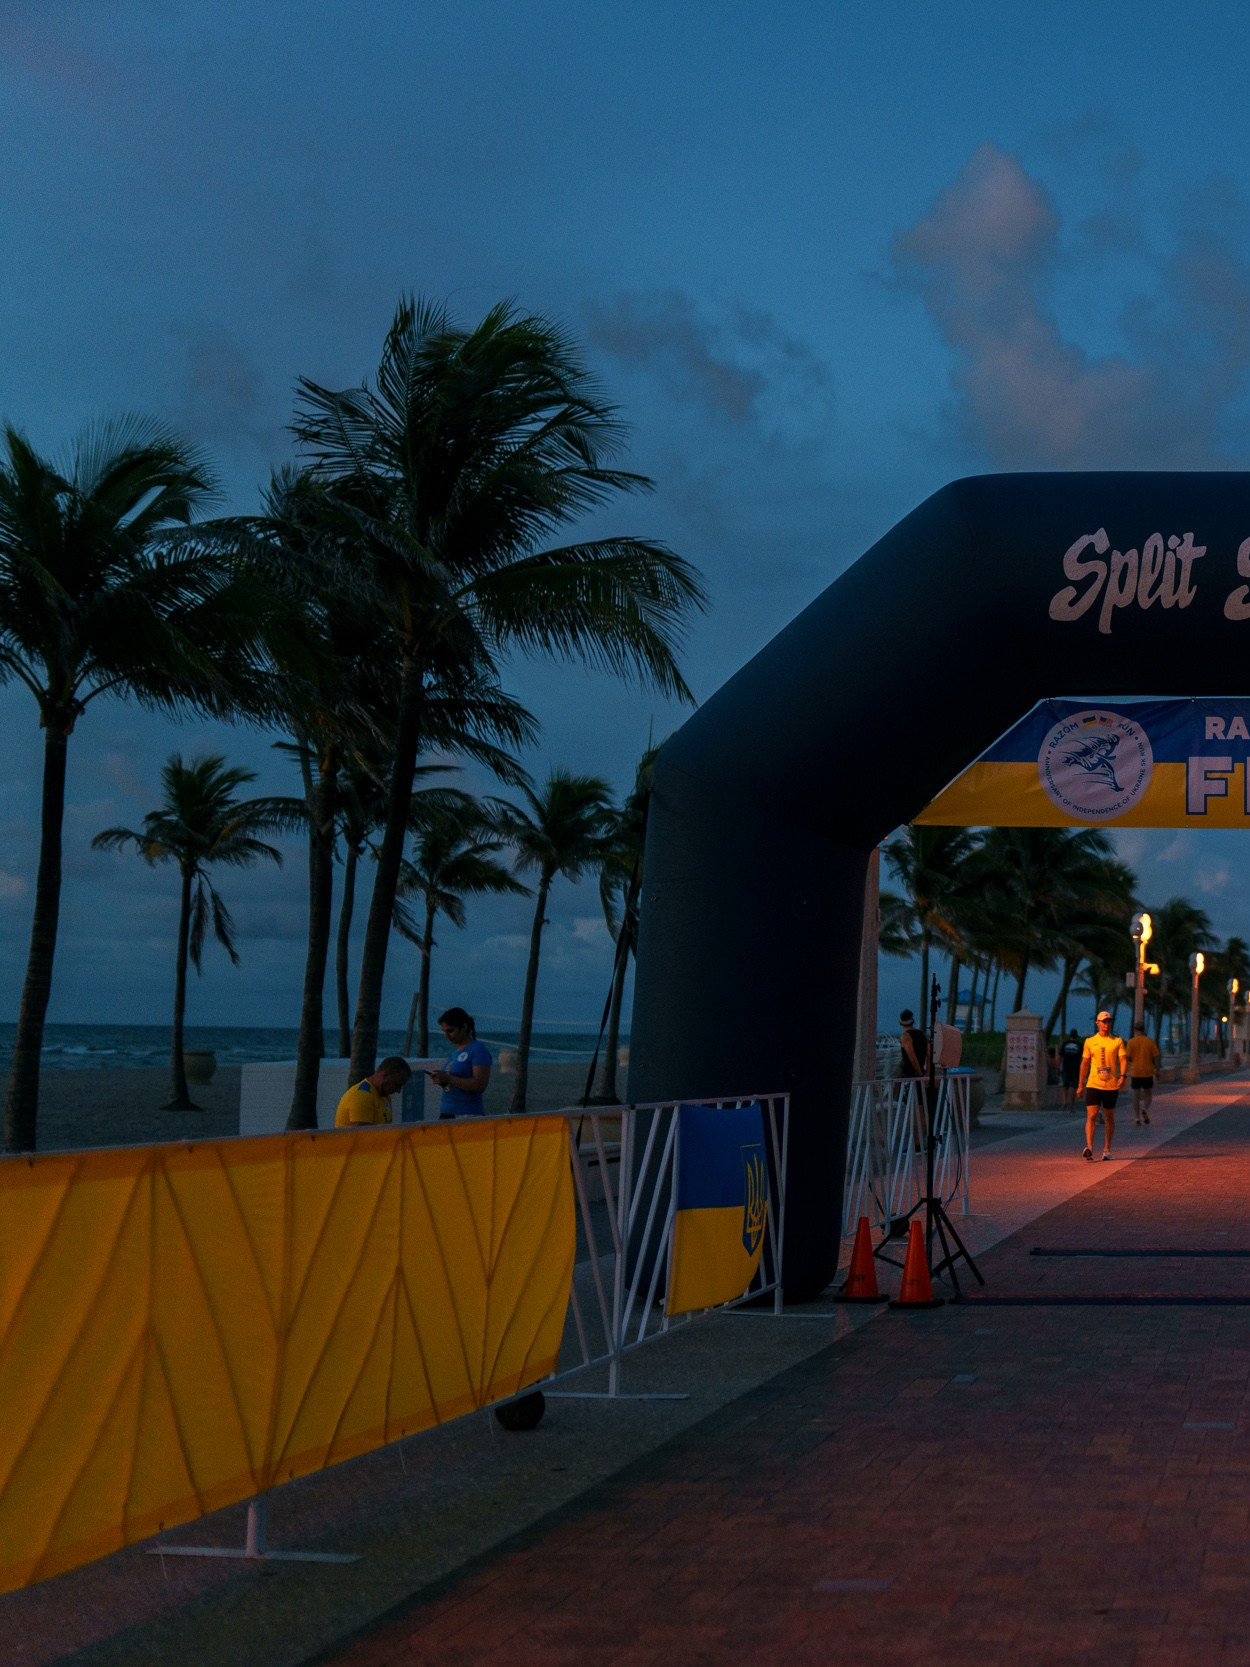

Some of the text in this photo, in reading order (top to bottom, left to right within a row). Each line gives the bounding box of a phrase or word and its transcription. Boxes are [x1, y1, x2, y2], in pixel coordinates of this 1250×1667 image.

[1049, 527, 1207, 634] Split
[1049, 722, 1079, 748] RAZOM
[1045, 756, 1063, 799] ANNIVERSARY
[1062, 798, 1072, 806] OF
[1072, 802, 1121, 815] INDEPENDENCE
[1122, 796, 1131, 804] OF
[1130, 768, 1146, 796] UKRAINE
